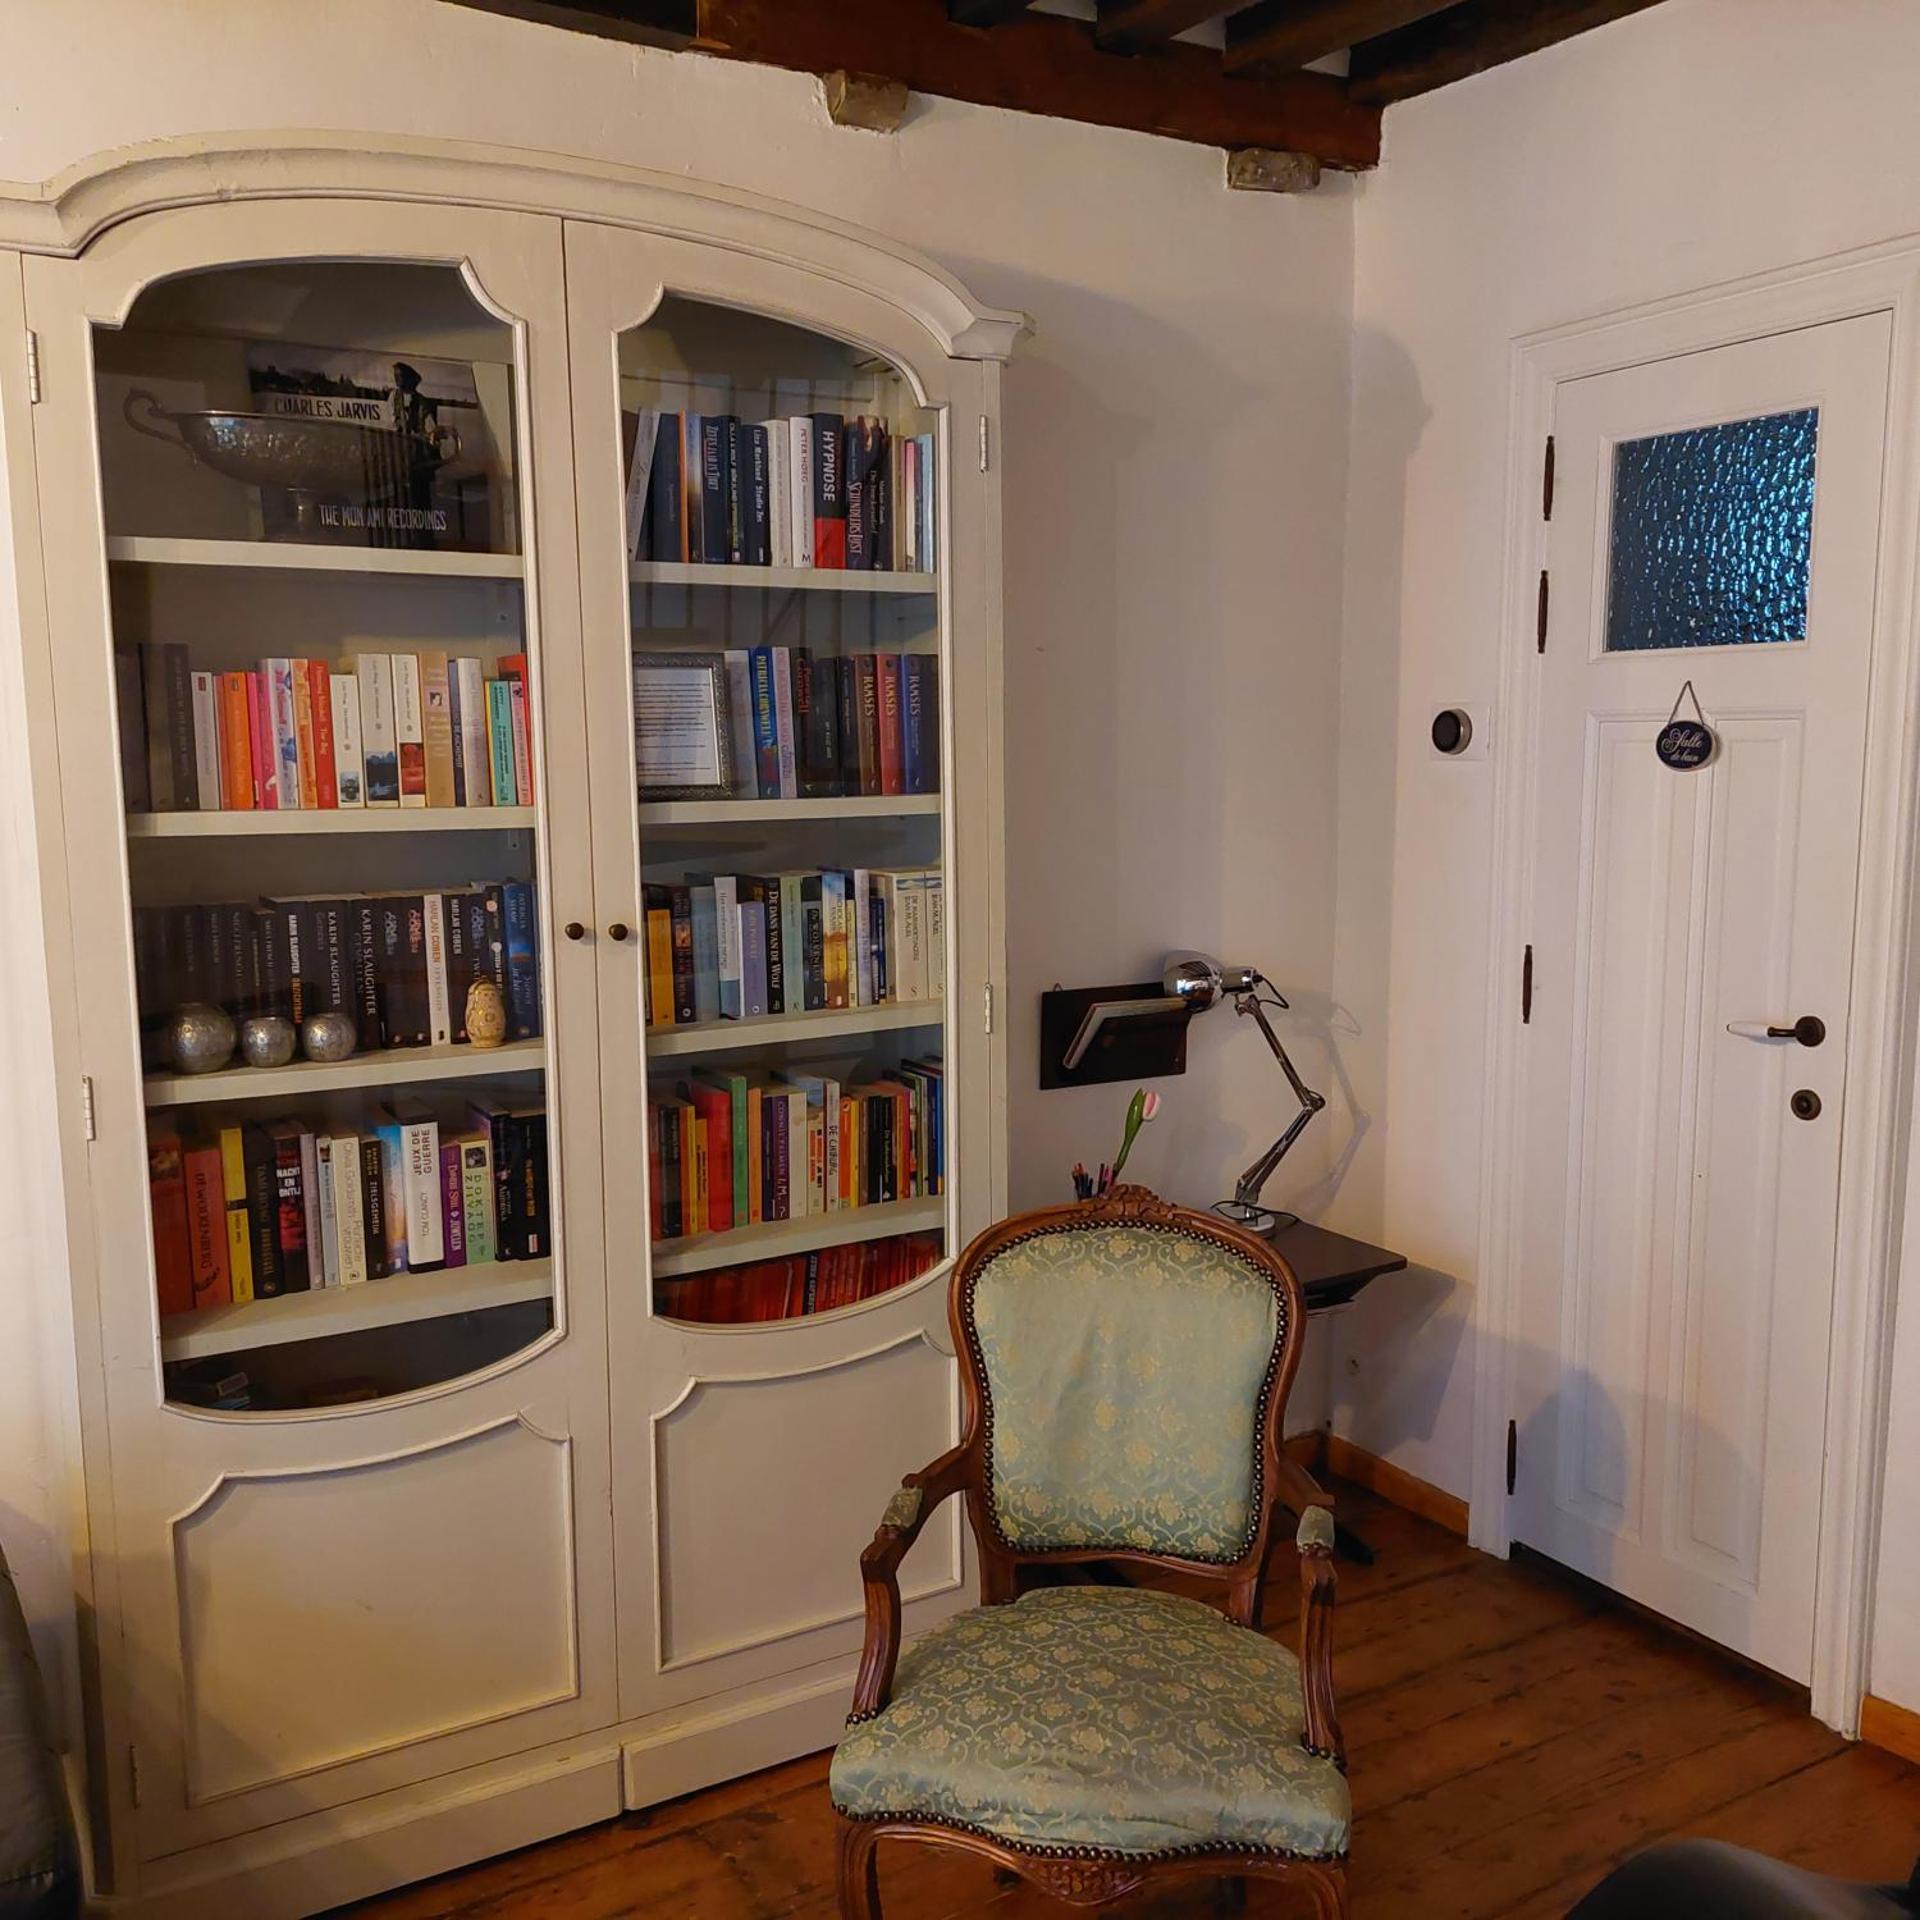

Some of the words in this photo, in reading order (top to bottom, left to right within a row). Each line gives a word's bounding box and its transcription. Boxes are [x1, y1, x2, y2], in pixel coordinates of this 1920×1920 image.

[274, 395, 333, 418] CHARLES
[336, 398, 383, 422] JARVIS
[800, 428, 809, 454] PETER
[822, 431, 836, 503] HYPNOSE
[318, 503, 339, 528] THE
[342, 505, 365, 529] MON
[366, 507, 385, 530] AMI
[387, 508, 447, 532] RECORDINGS
[863, 676, 875, 717] RAMSES
[884, 675, 897, 716] RAMSES
[909, 675, 921, 715] RAMSES
[768, 891, 780, 905] DE
[288, 914, 298, 936] KARIN
[327, 911, 338, 945] KARIN
[361, 909, 373, 945] KARIN
[429, 901, 439, 935] HARLAN
[450, 899, 461, 928] HARLAN
[769, 906, 780, 929] DANS
[290, 936, 300, 974] SLAUGHTER
[431, 935, 441, 964] COBEN
[451, 928, 462, 955] COBEN
[770, 931, 780, 950] VAN
[770, 950, 780, 962] DE
[330, 946, 342, 1006] SLAUGHTER
[363, 947, 376, 1016] SLAUGHTER
[770, 963, 781, 988] WOLF
[777, 1101, 787, 1136] CONNIE
[828, 1125, 838, 1137] DE
[411, 1130, 421, 1145] DE
[421, 1129, 433, 1175] GUERRE
[276, 1166, 301, 1178] NACHT
[411, 1149, 422, 1176] JEUX
[419, 1192, 429, 1222] CLANCY
[464, 1174, 475, 1244] ZJIVAGO
[473, 1174, 484, 1241] DOKTER
[421, 1222, 429, 1237] TOM
